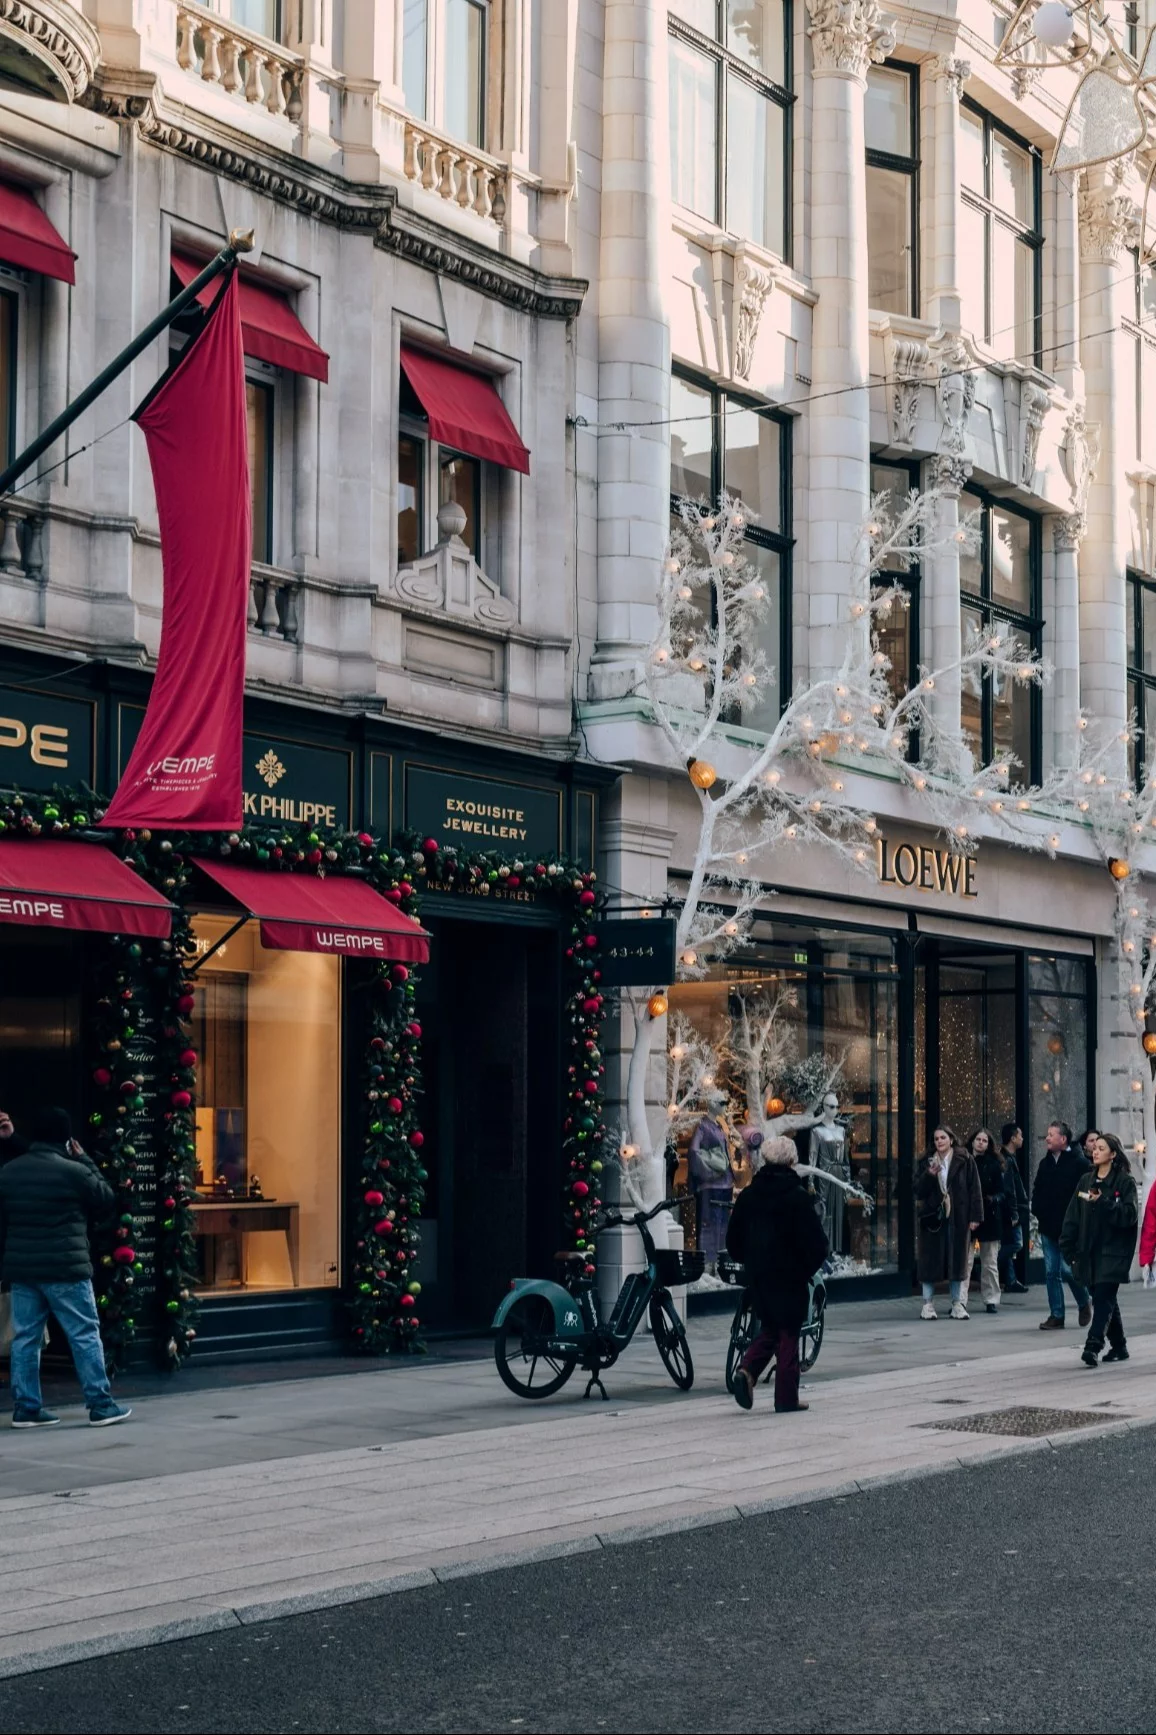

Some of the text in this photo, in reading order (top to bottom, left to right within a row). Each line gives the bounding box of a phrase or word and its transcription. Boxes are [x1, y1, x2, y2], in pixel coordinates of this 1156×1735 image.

[260, 795, 336, 828] PHILIPPE
[446, 798, 524, 823] EXQUISITE
[442, 818, 527, 840] JEWELLERY
[879, 839, 978, 898] LOEWE
[427, 880, 452, 892] NEW
[316, 931, 385, 951] WEMPE
